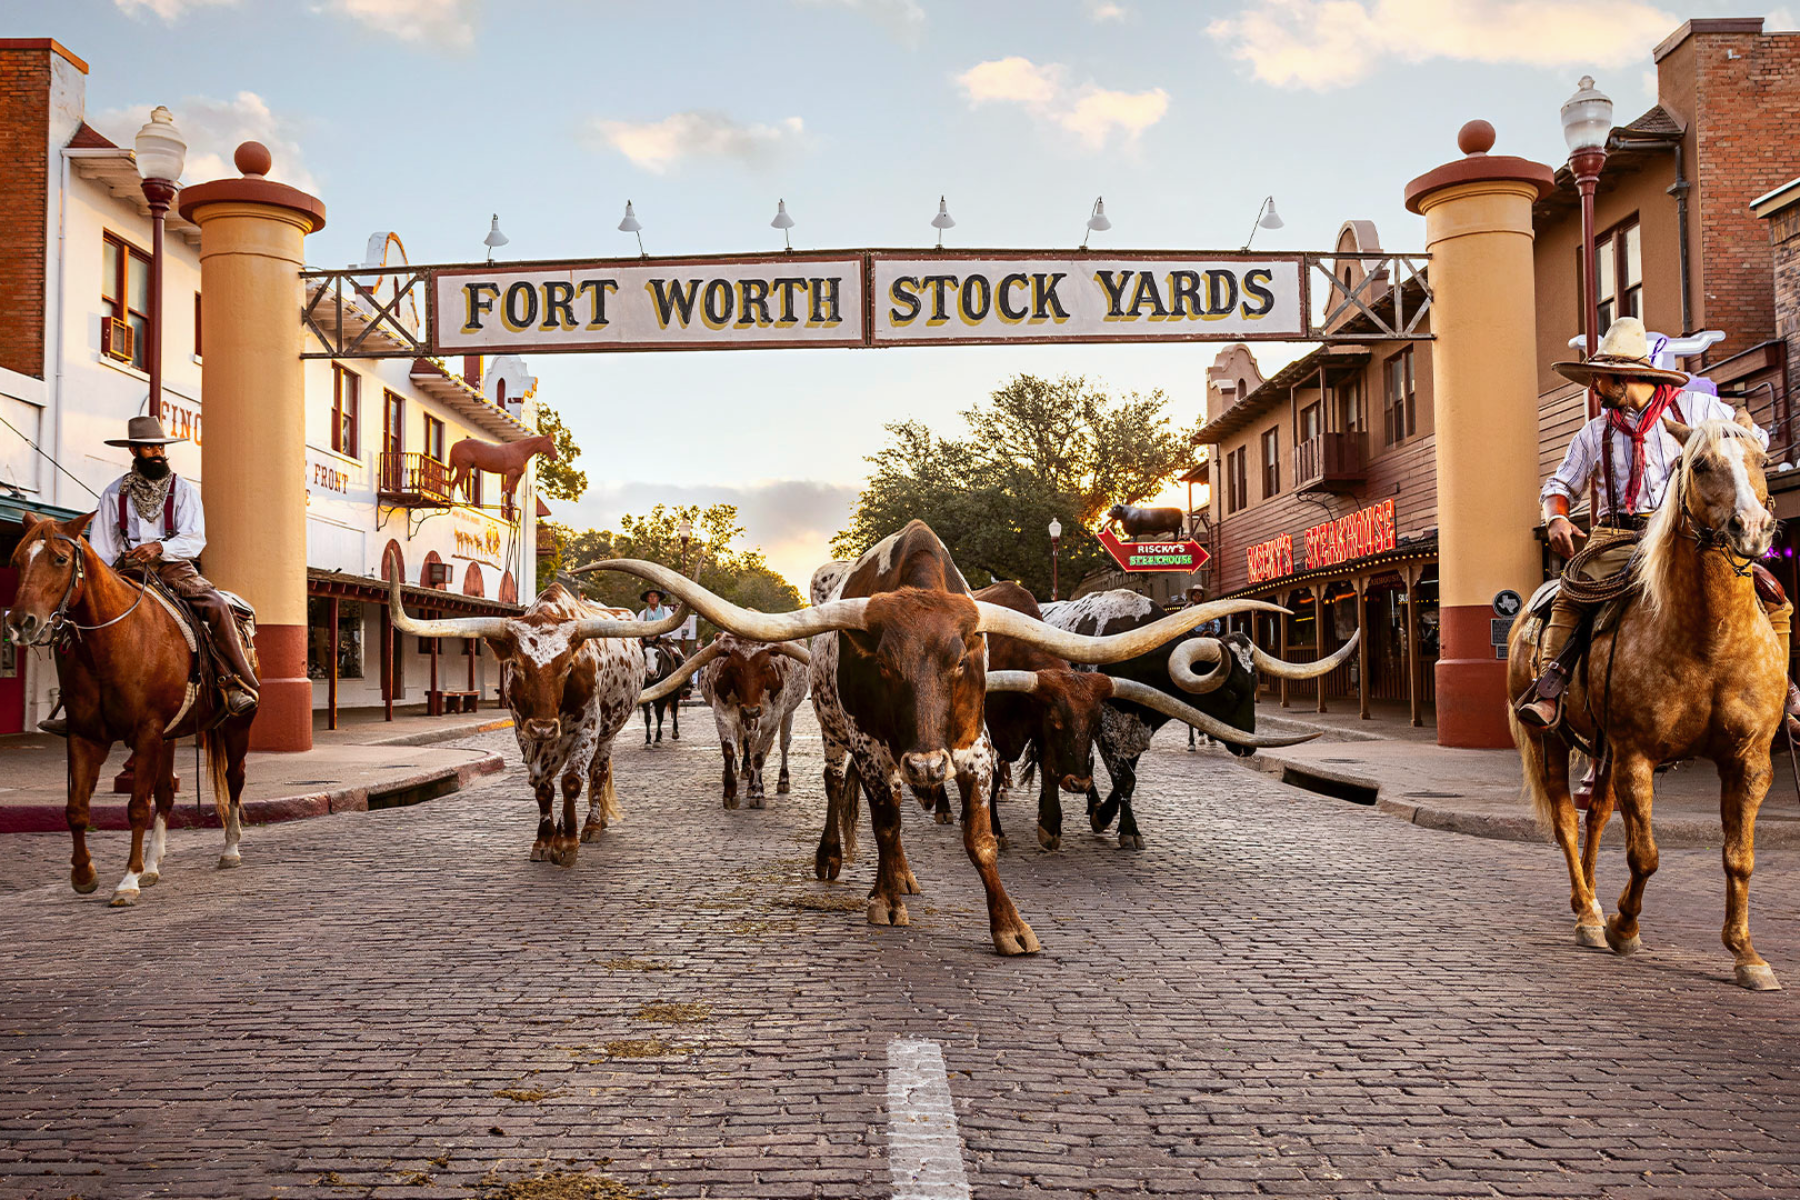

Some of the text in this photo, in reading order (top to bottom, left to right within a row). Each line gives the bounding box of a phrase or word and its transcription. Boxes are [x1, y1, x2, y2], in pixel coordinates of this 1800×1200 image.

[460, 268, 1275, 334] FORT WORTH STOCK YARDS
[314, 463, 349, 495] FRONT
[1137, 544, 1186, 554] RISCKY'S
[1247, 498, 1397, 584] RISCKY'S STEAKHOUSE
[1129, 554, 1193, 566] STEAKHOUSE
